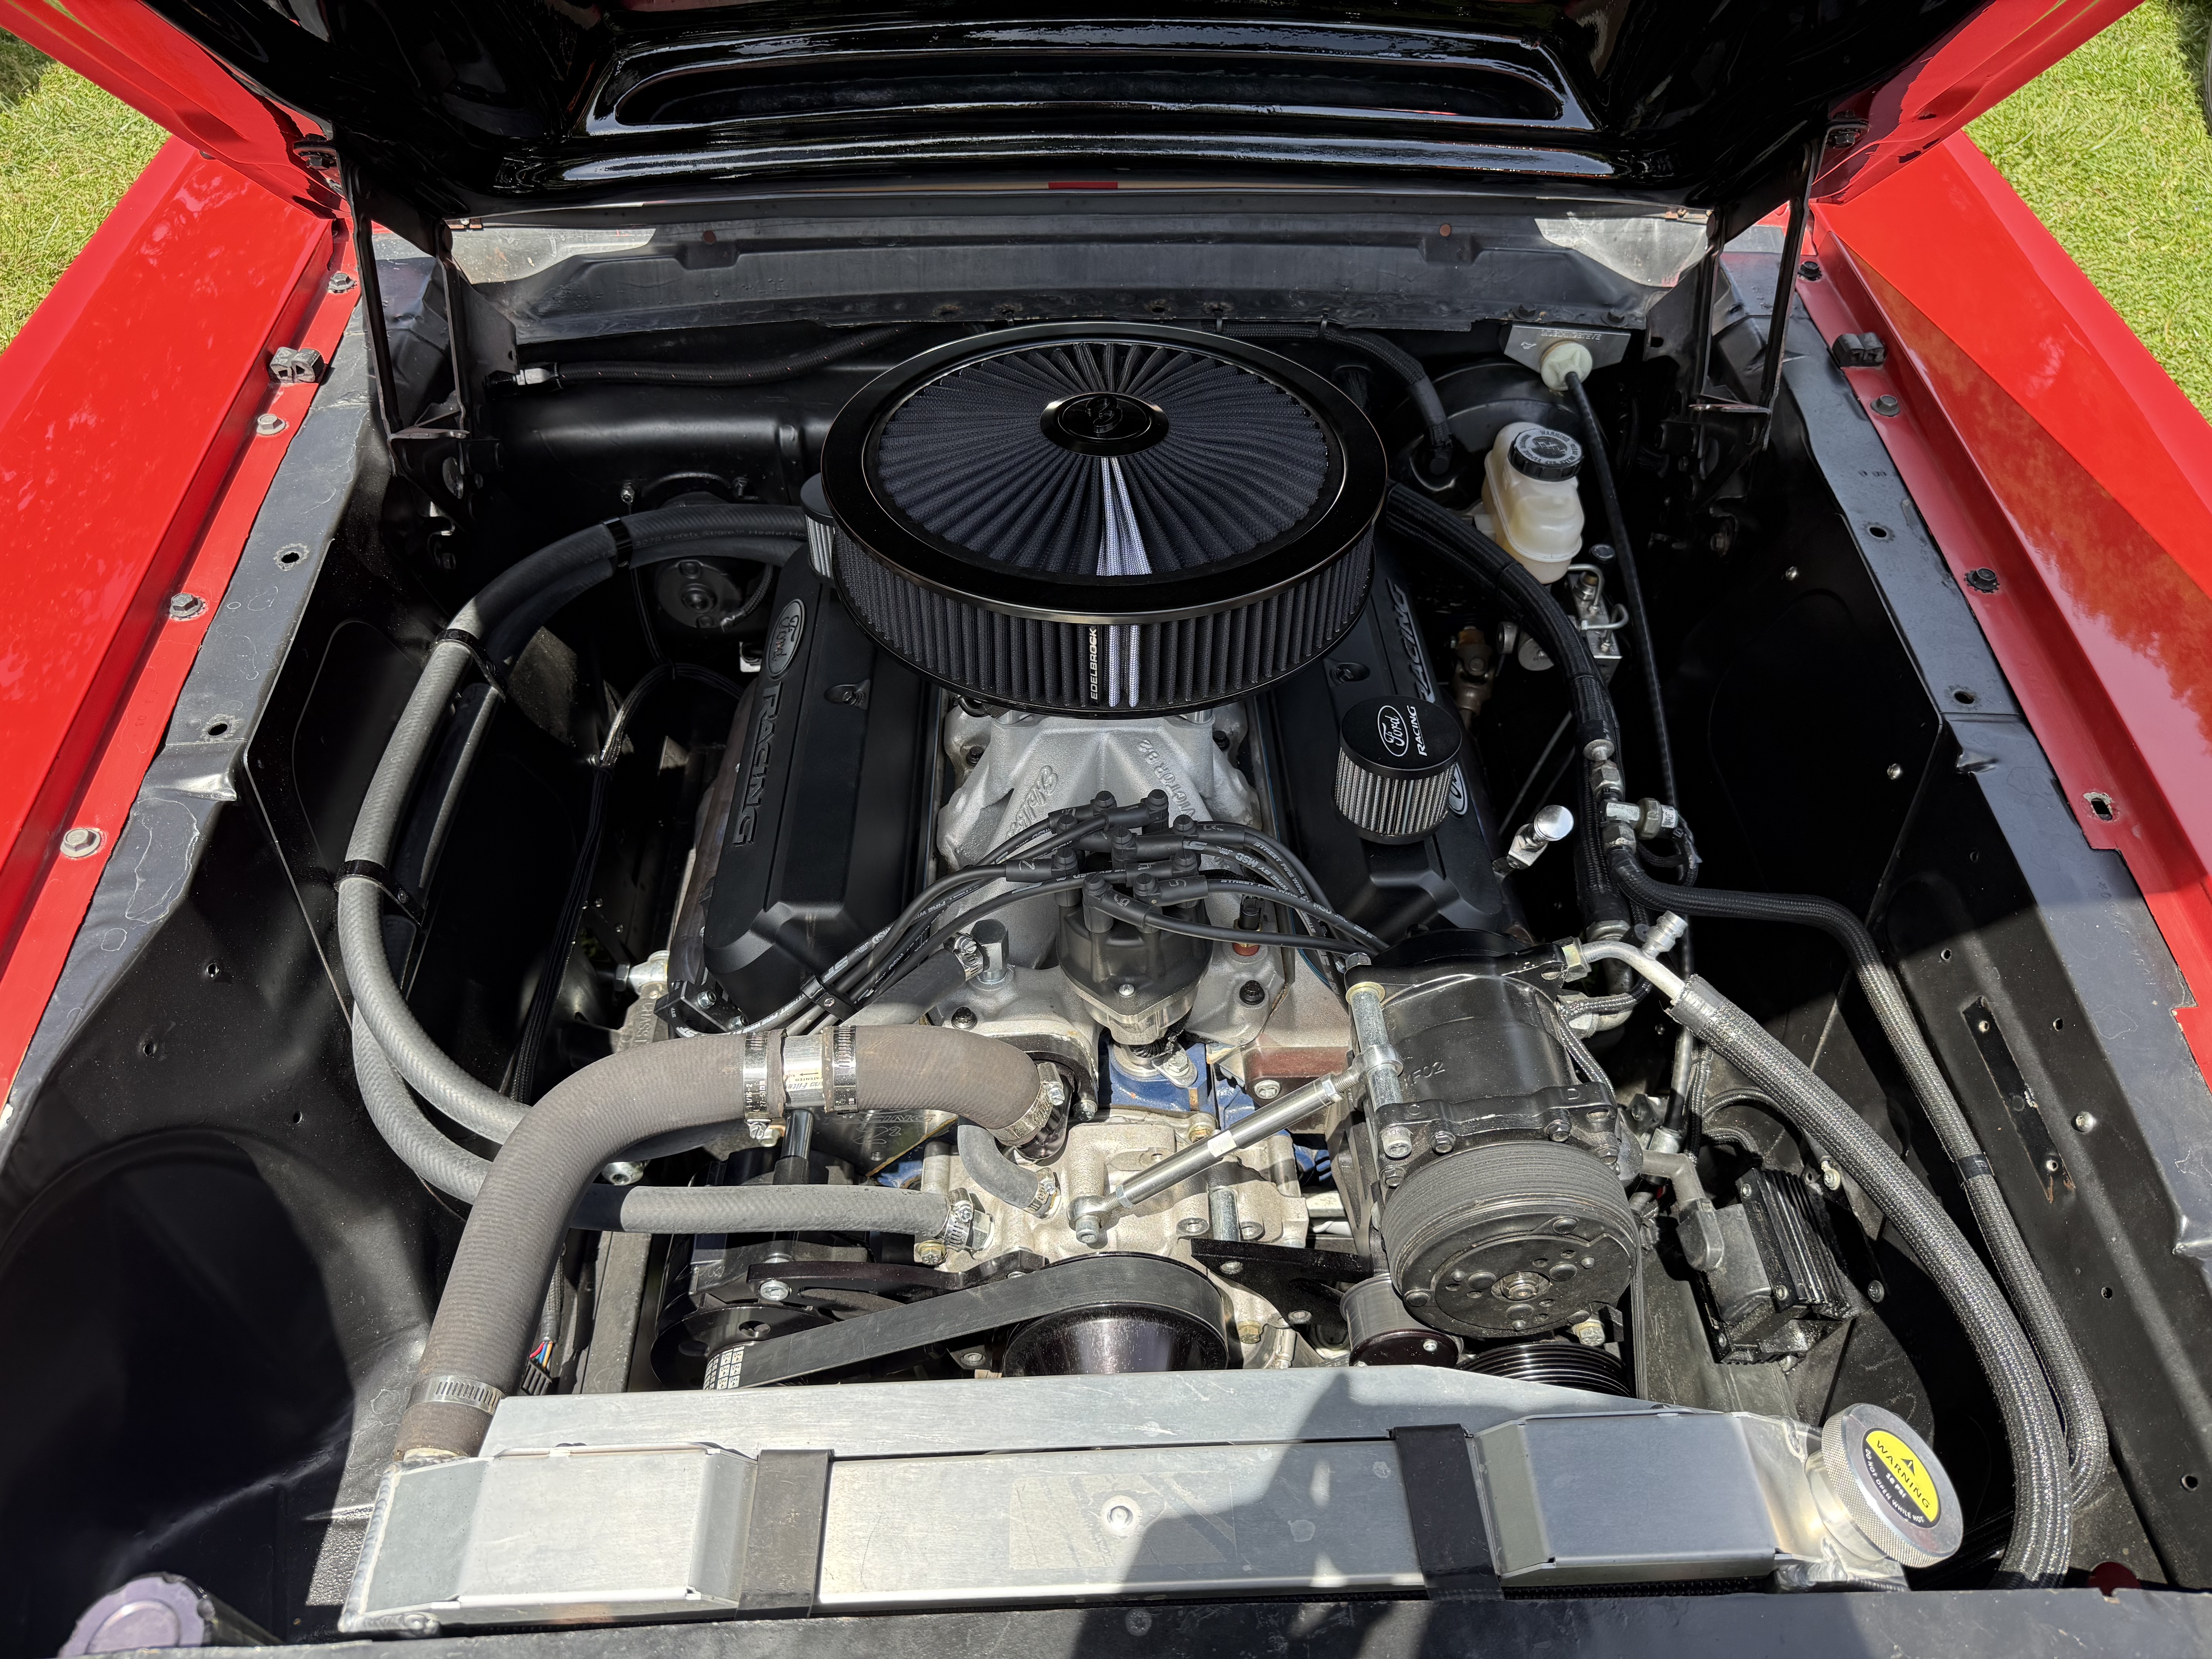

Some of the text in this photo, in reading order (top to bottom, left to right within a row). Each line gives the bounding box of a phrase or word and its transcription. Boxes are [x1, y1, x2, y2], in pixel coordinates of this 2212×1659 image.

[1090, 627, 1098, 701] EDELBROCK
[1386, 715, 1406, 749] Ford
[1407, 705, 1427, 757] RACING
[732, 681, 784, 847] RACING
[1235, 852, 1259, 868] MSD
[1257, 867, 1271, 876] BY
[1865, 1448, 1925, 1524] DO NOT OPEN WHILE HOT
[1876, 1440, 1930, 1508] WARNING
[1894, 1483, 1907, 1498] PSI
